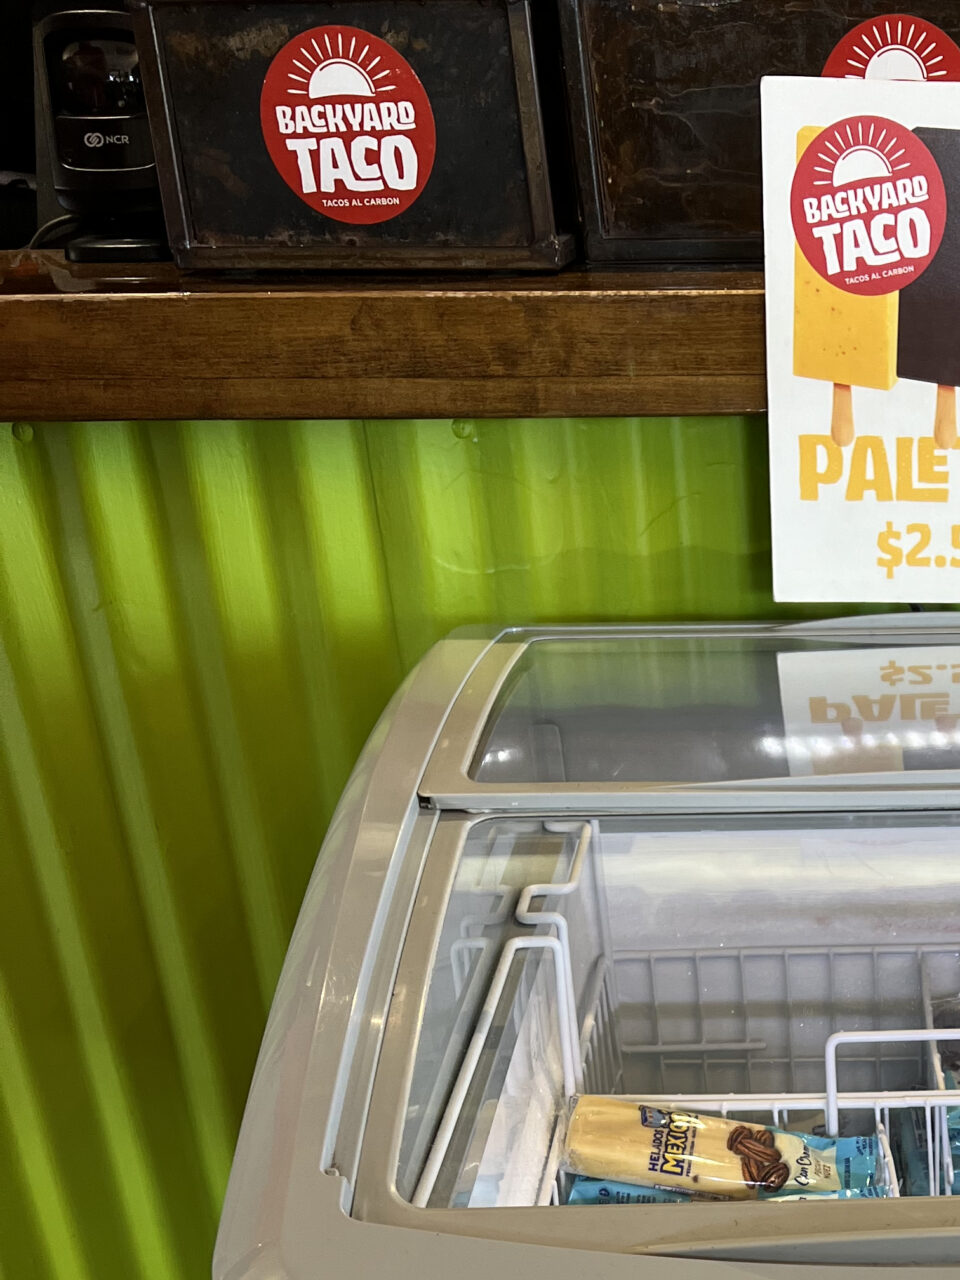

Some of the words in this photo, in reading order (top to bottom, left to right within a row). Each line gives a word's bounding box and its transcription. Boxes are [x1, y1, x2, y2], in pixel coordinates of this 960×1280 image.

[275, 101, 416, 135] BACKYARD
[105, 135, 129, 144] NCR
[285, 134, 419, 194] TACO
[322, 199, 349, 207] TACOS
[351, 198, 363, 206] AL
[364, 197, 400, 206] CARBON
[803, 174, 928, 224] BACKYARD
[813, 207, 931, 276] TACO
[844, 275, 869, 285] TACOS
[871, 272, 883, 281] AL
[884, 266, 915, 277] CARBON
[660, 1111, 690, 1176] MEXICO
[794, 1167, 809, 1186] Con
